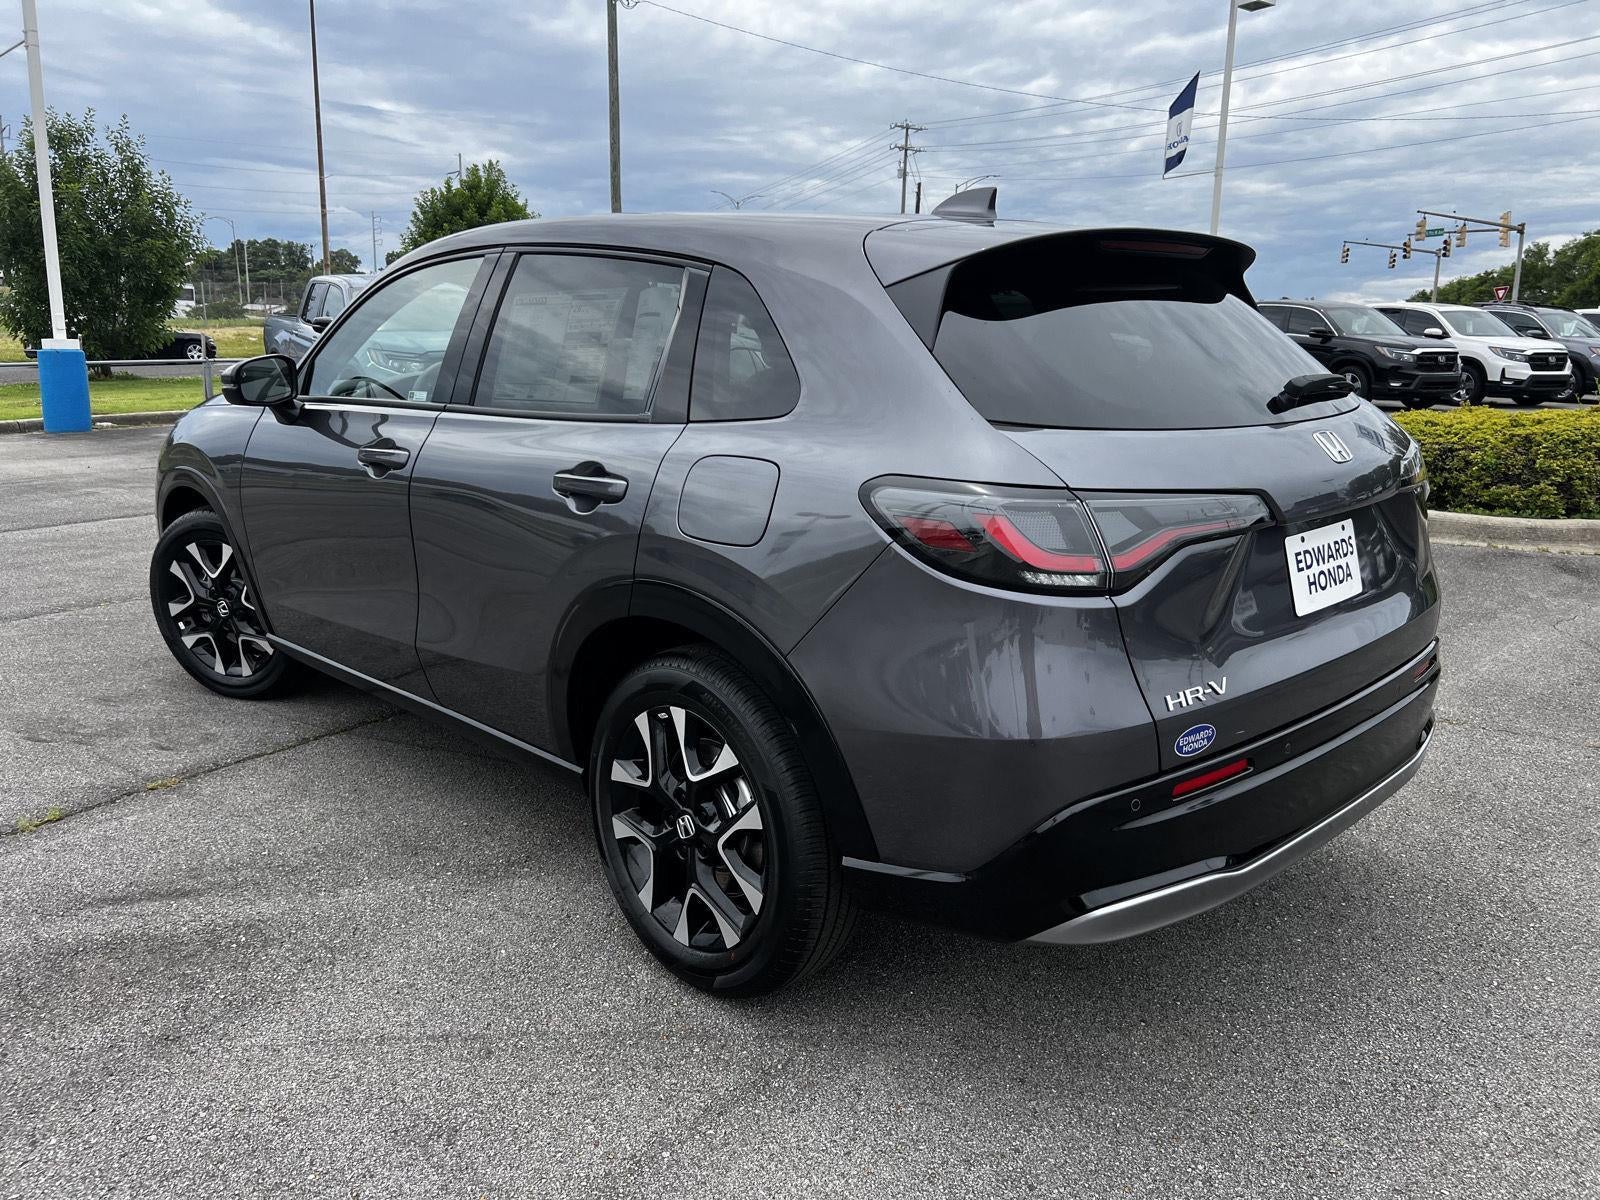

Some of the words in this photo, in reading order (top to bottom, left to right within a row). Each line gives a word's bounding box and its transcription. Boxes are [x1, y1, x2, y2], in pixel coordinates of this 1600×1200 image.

[1294, 535, 1354, 573] EDWARDS
[1307, 561, 1353, 595] HONDA
[1164, 676, 1227, 712] HR-V
[1179, 728, 1213, 747] EDWARDS
[1182, 738, 1208, 754] HONDA
